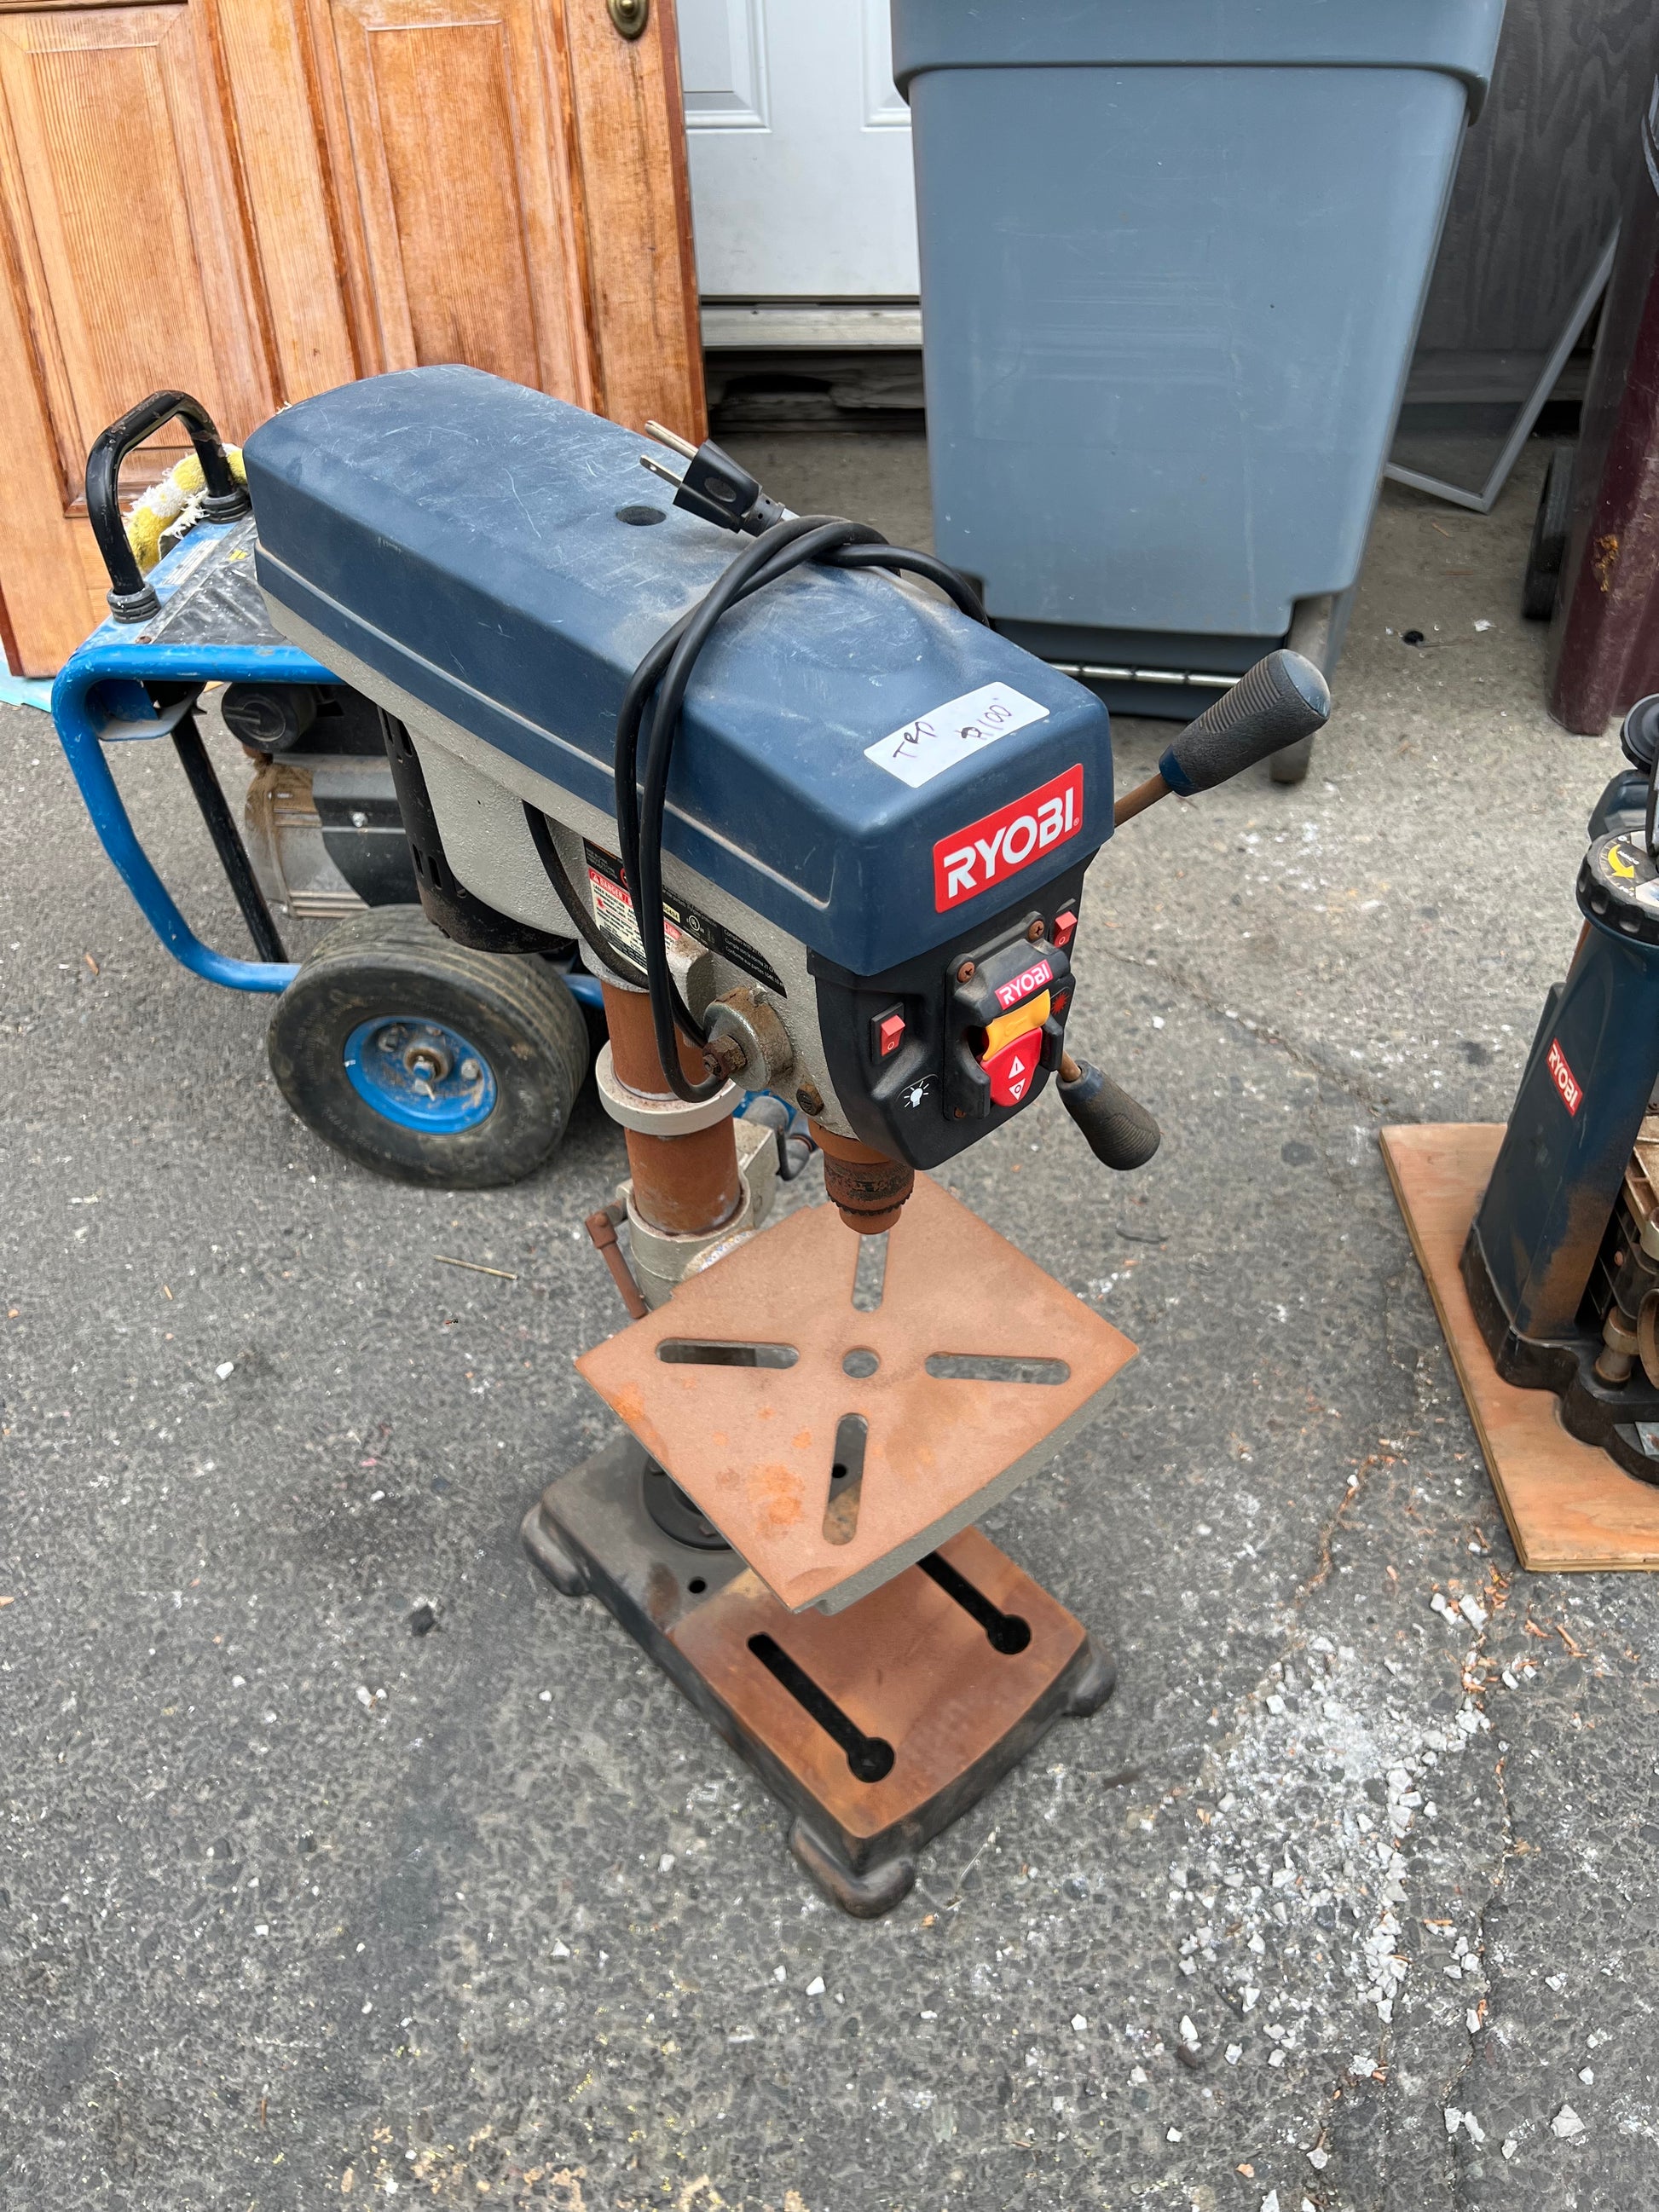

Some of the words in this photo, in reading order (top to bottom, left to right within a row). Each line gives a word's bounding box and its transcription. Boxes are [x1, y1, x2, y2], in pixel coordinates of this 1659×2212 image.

[944, 787, 1074, 898] RYOBI
[999, 963, 1050, 1005] RYOBI
[1548, 1043, 1578, 1107] RYOBI
